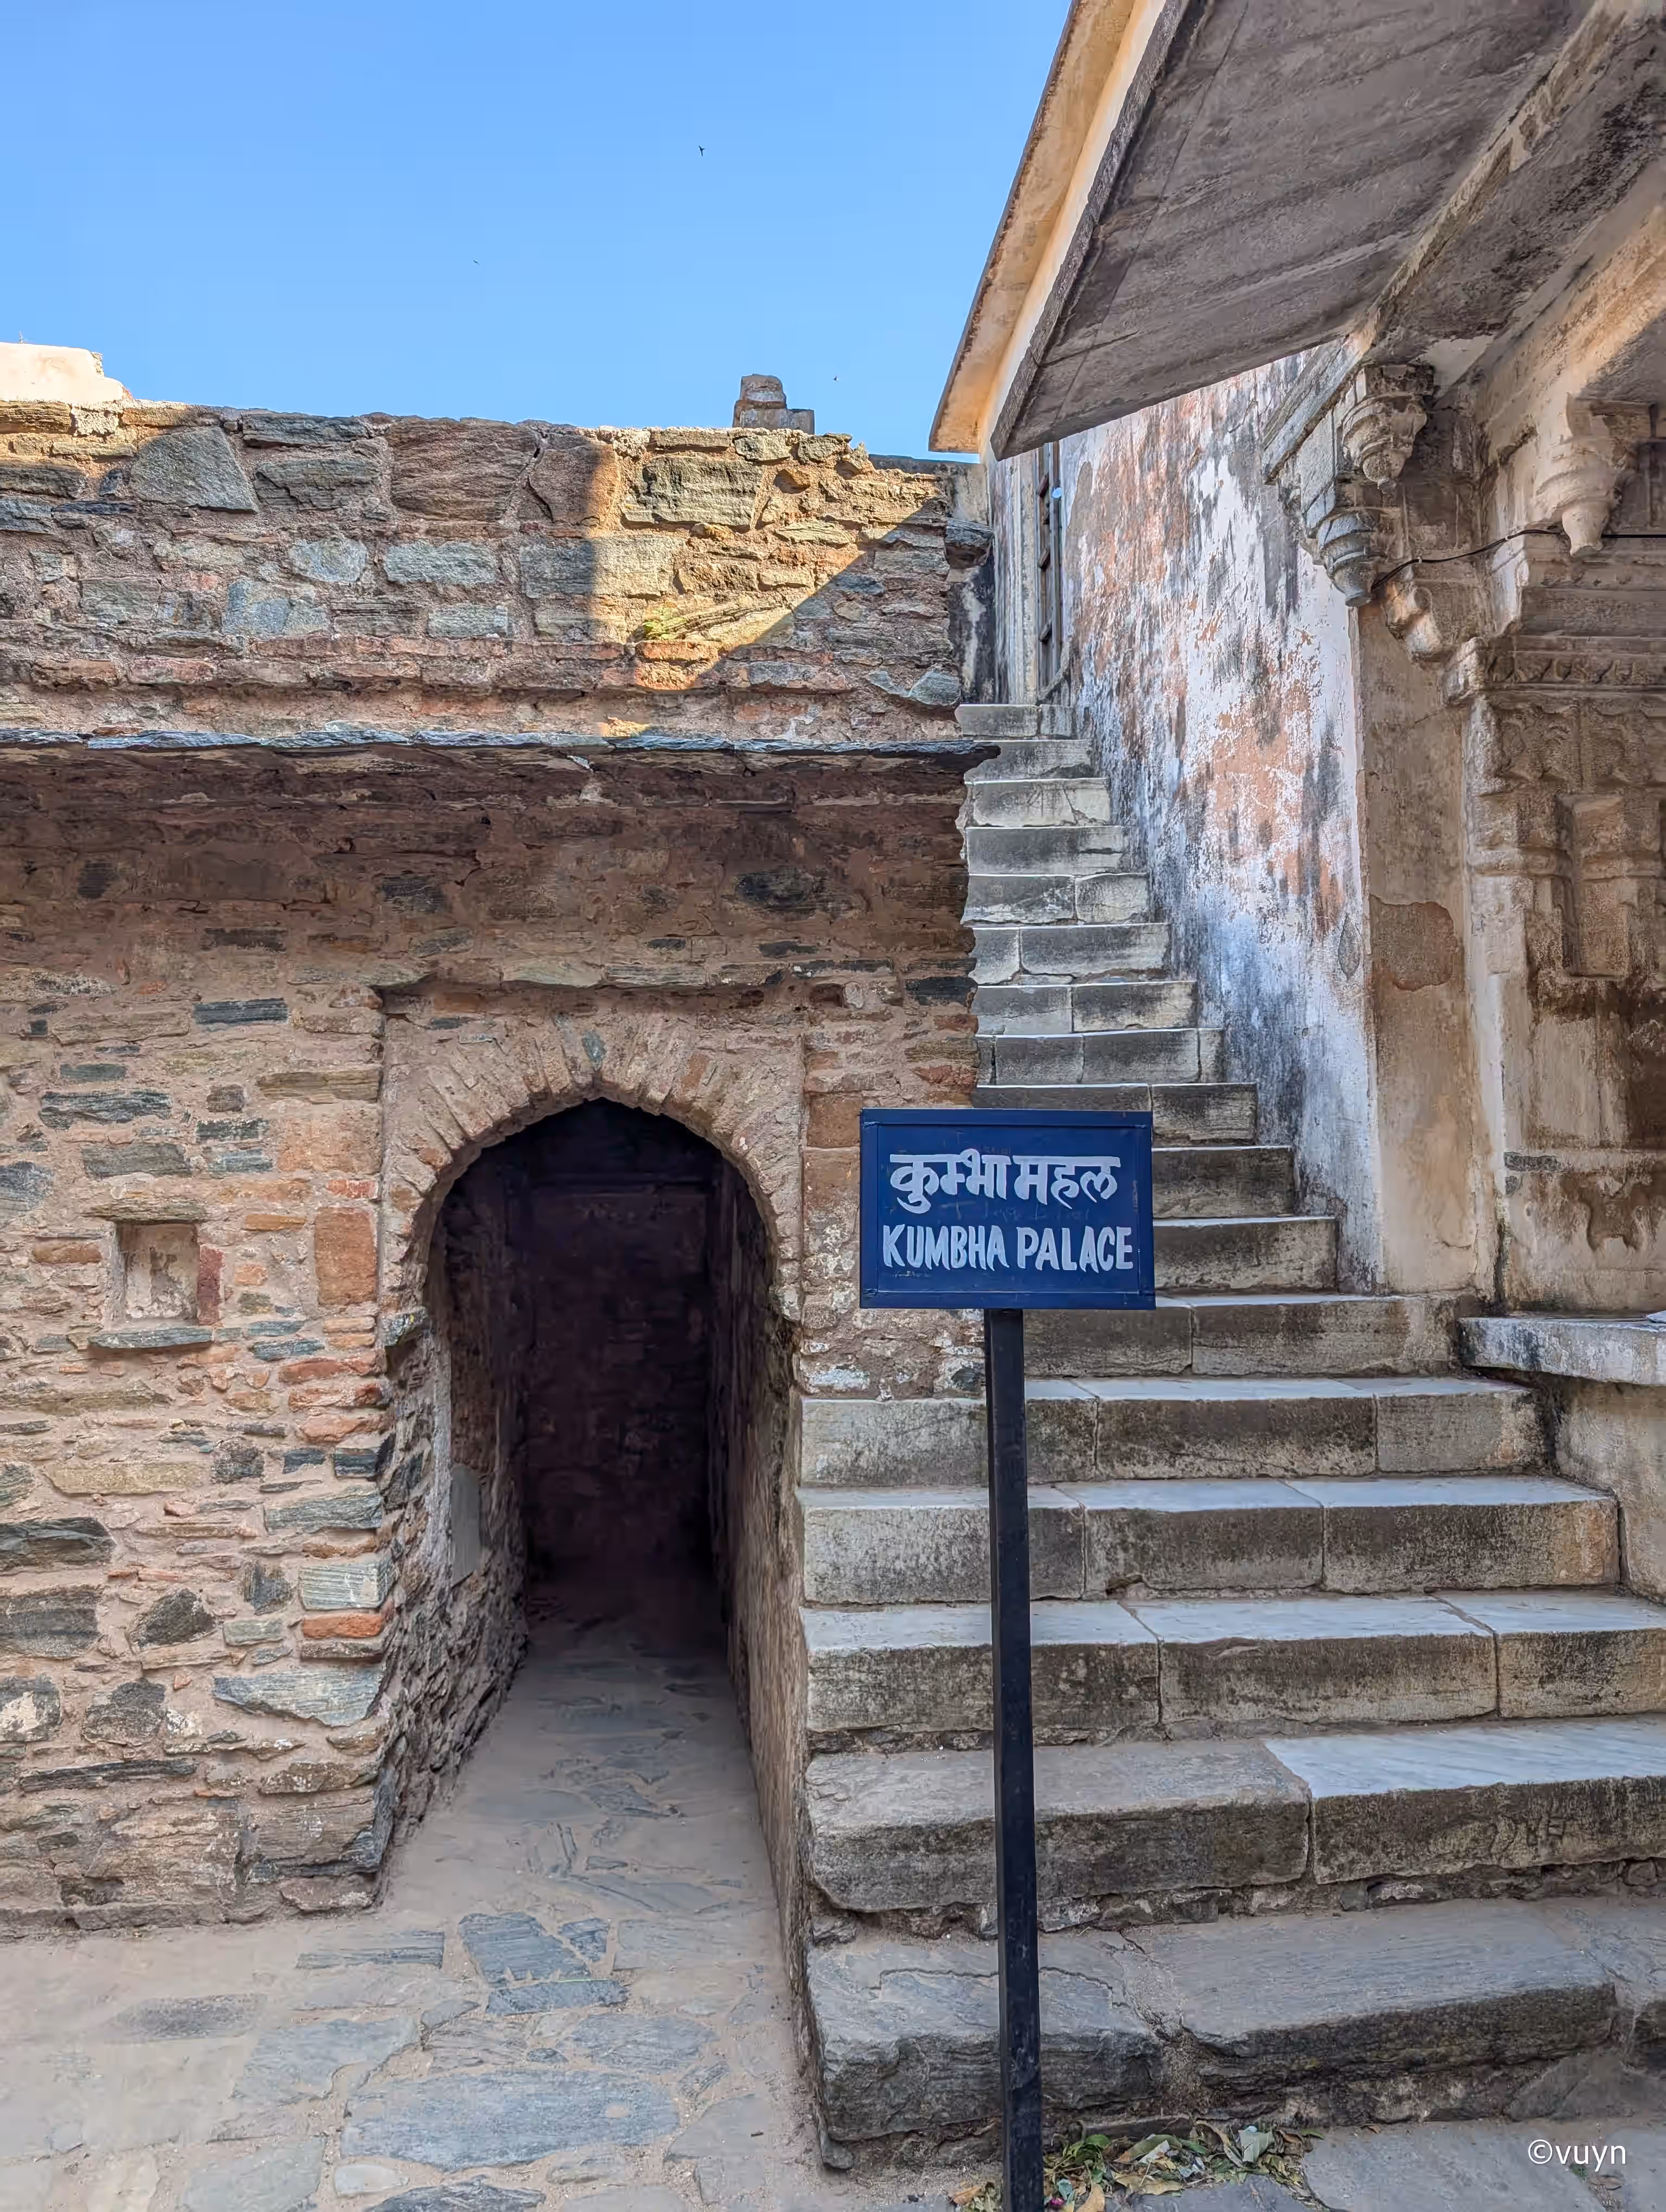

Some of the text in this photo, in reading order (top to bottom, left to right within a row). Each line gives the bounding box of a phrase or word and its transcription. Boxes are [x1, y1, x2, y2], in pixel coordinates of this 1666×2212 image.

[1013, 1155, 1121, 1209] महल
[883, 1224, 1133, 1273] KUMBHA PALACE
